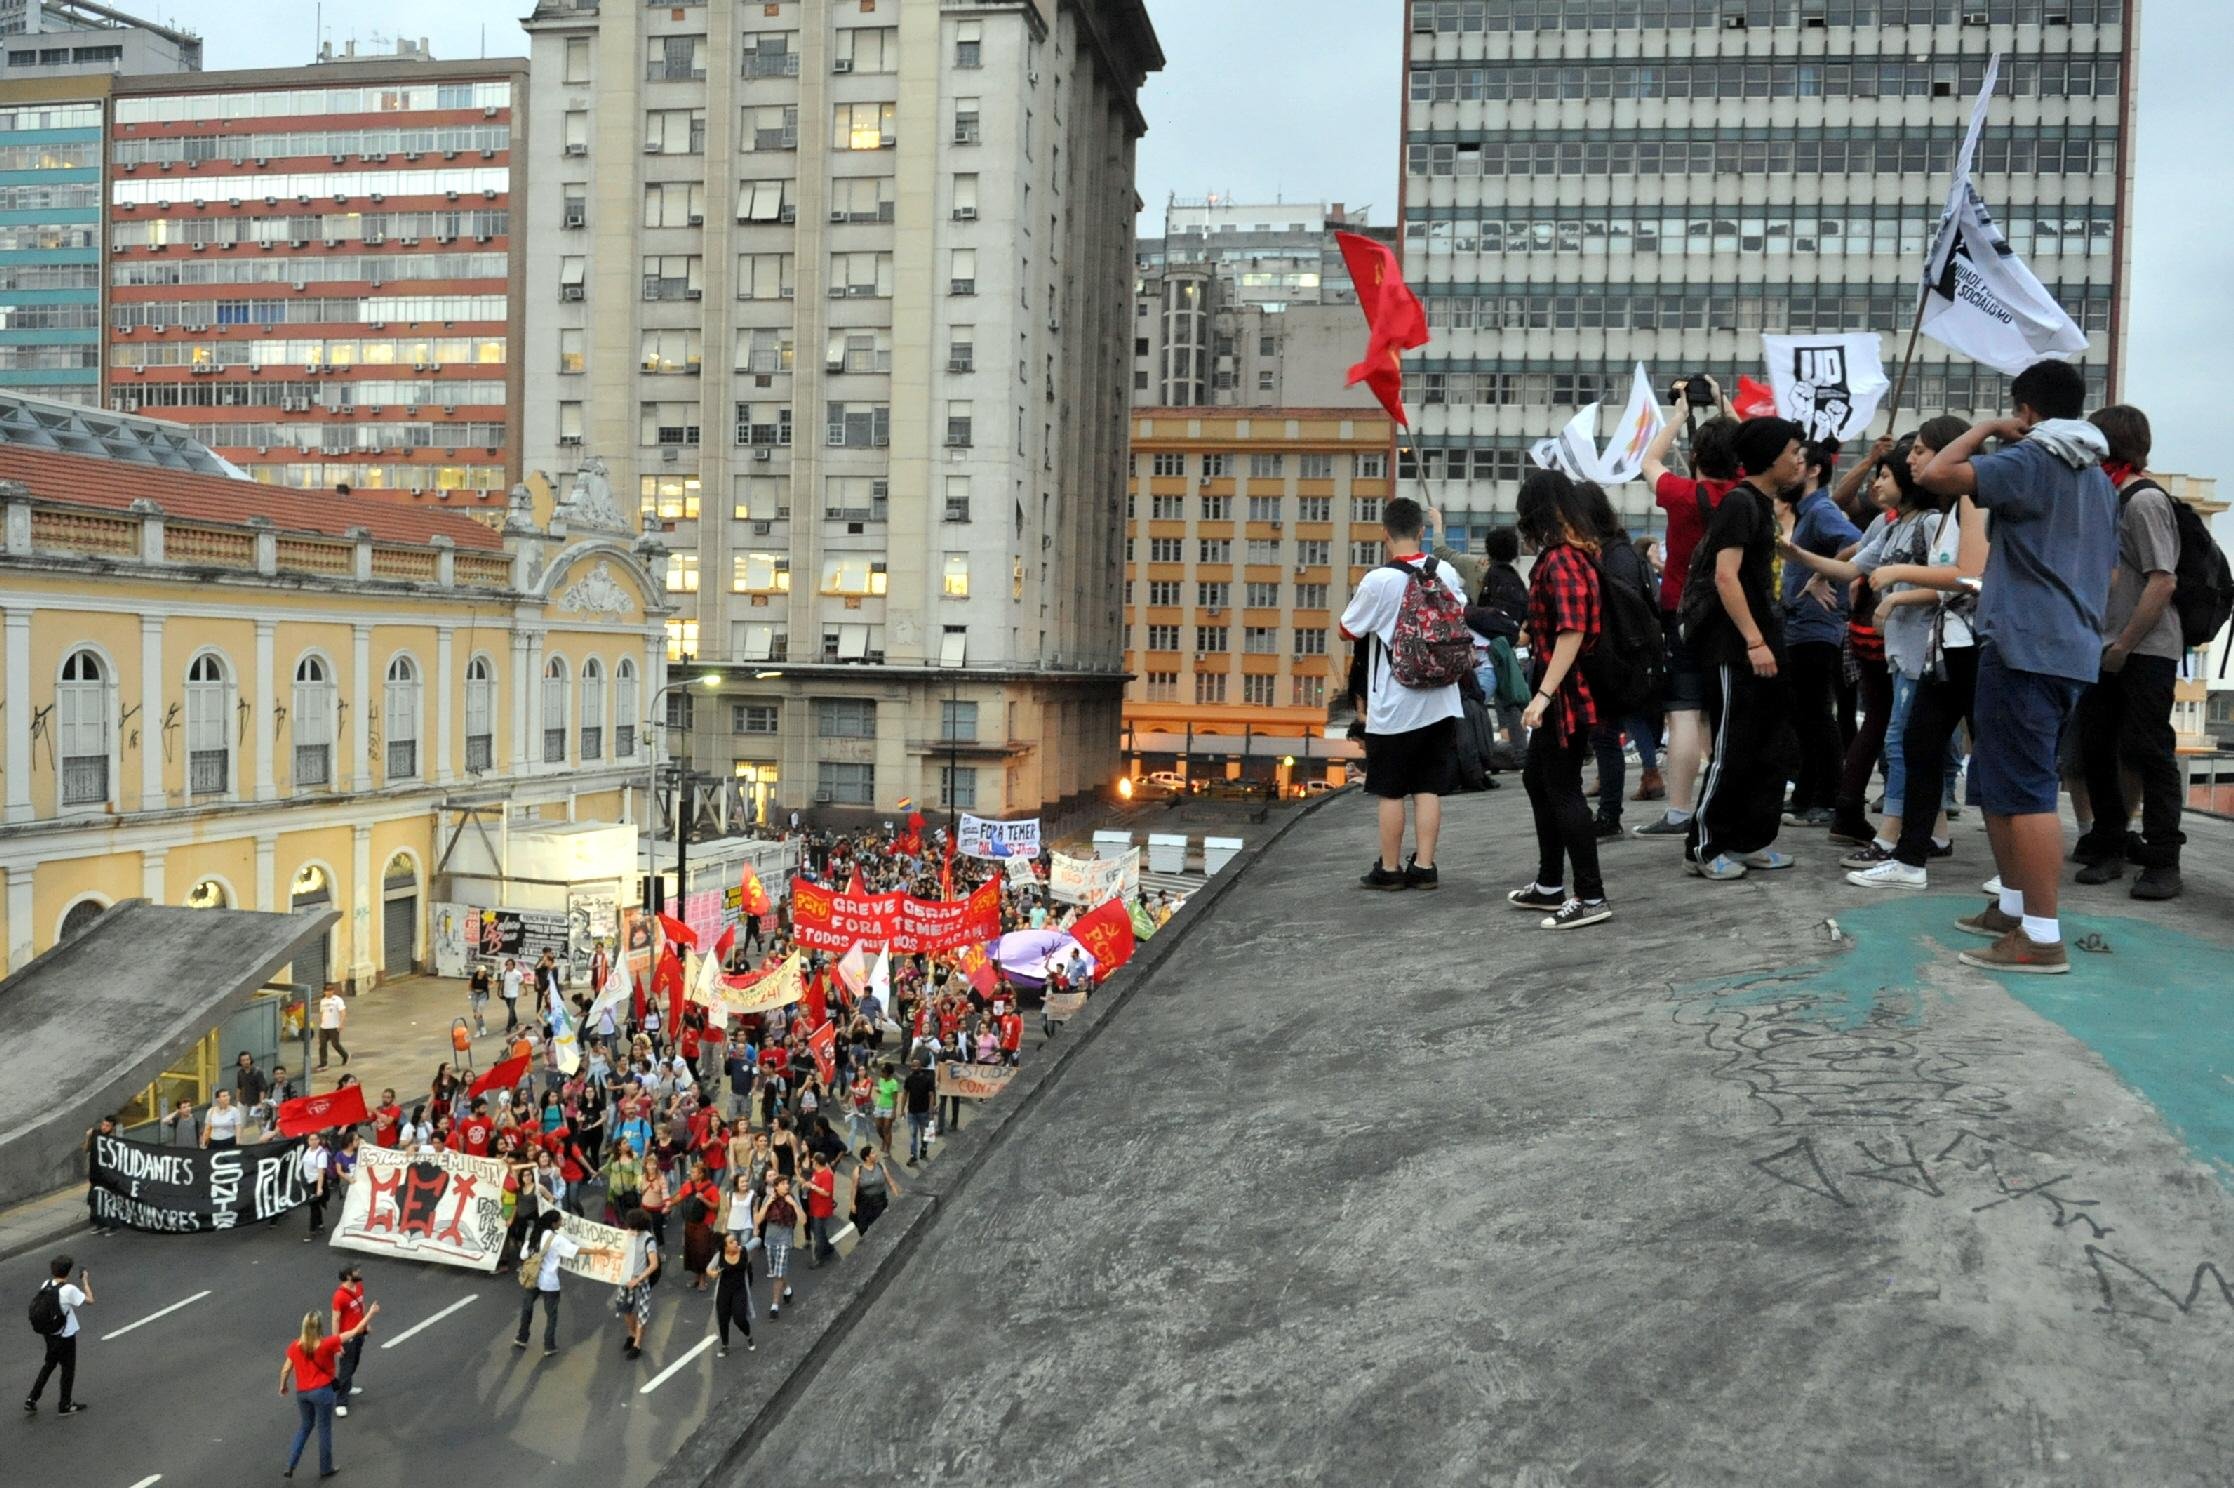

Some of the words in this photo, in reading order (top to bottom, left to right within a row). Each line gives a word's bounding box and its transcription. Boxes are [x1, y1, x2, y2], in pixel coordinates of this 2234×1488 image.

[1953, 262, 1983, 290] NIDADE
[1957, 284, 2013, 324] SOCIALISMO
[1007, 824, 1036, 840] TEMER
[833, 898, 896, 915] GREVE
[831, 915, 882, 935] FORA
[793, 925, 803, 939] E
[805, 927, 849, 947] TODOS
[97, 1134, 194, 1186] ESTUDANTES
[131, 1180, 140, 1198] E
